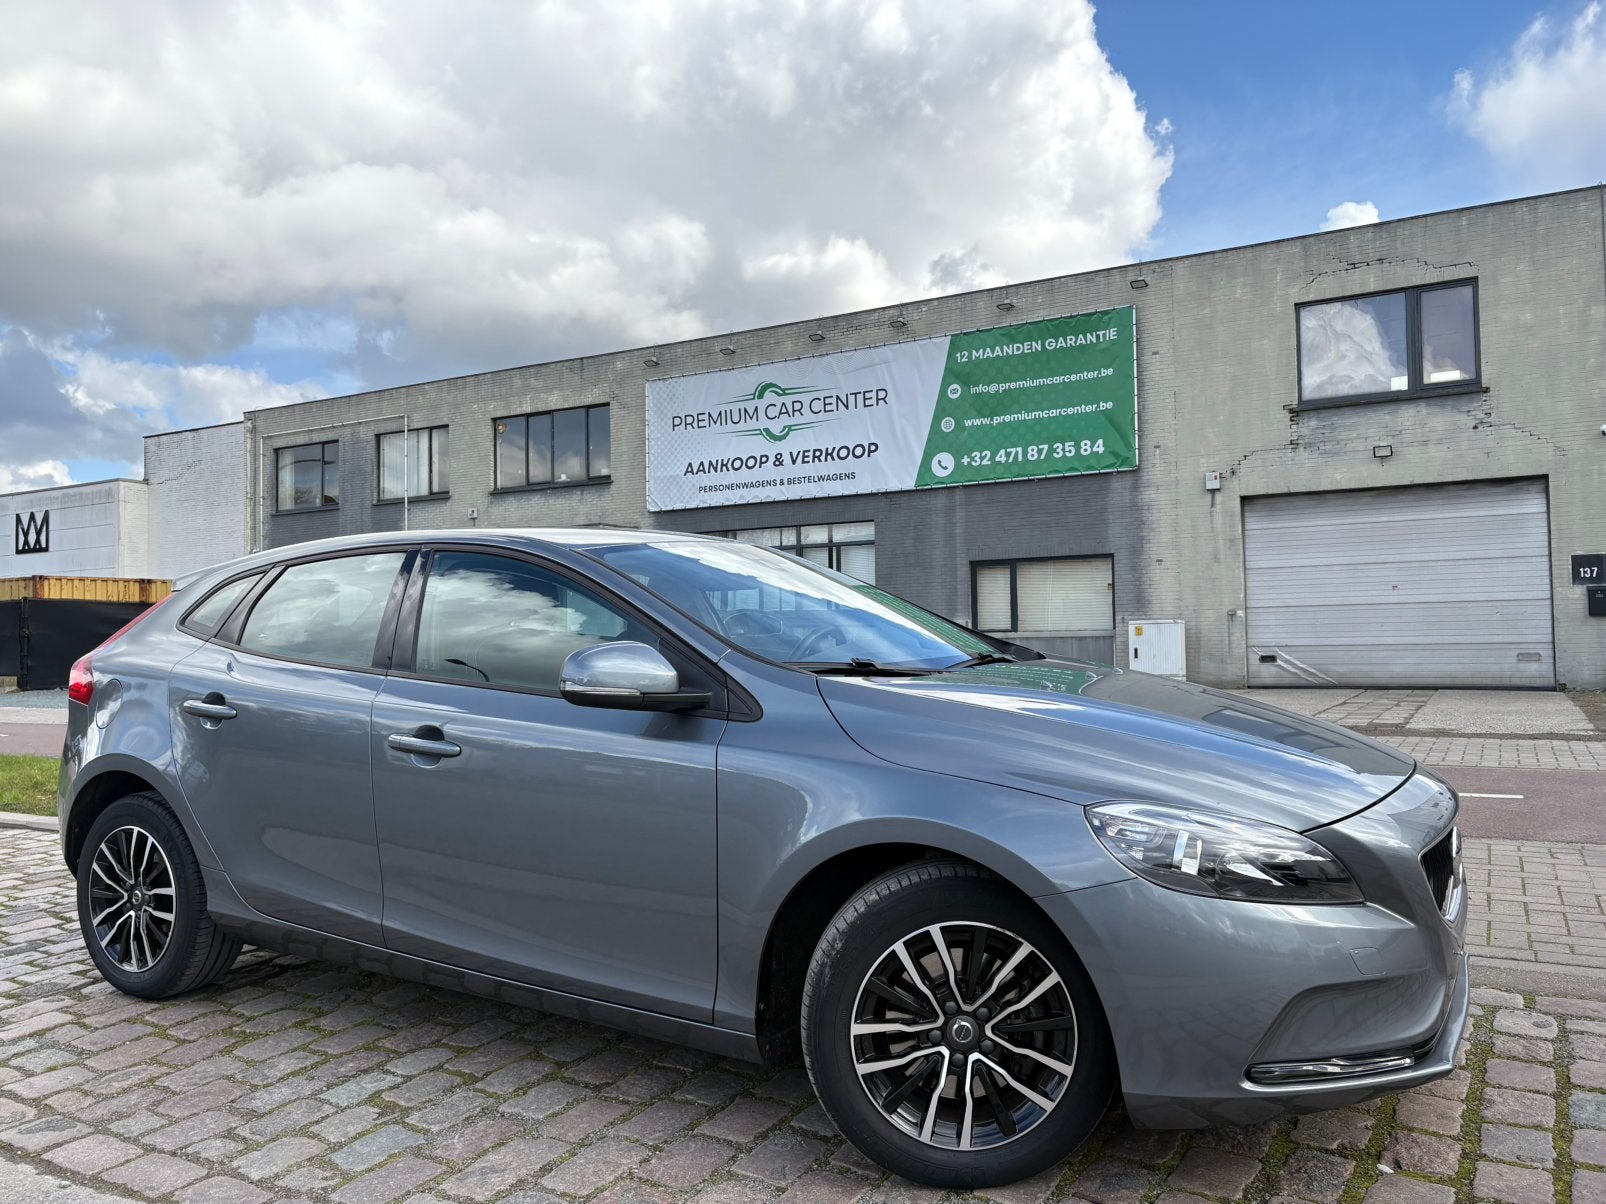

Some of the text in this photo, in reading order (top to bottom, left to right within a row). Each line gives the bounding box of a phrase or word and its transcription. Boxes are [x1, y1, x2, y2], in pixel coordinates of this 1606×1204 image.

[955, 328, 1118, 363] 12 MAANDEN GARANTIE
[970, 367, 1113, 395] info@premiumcarcenter.be
[672, 387, 889, 432] PREMIUM CAR CENTER
[964, 401, 1113, 427] www.premiumcarcenter.be
[684, 442, 879, 477] AANKOOP & VERKOOP
[961, 438, 1105, 466] +32 471 87 35 84
[698, 471, 856, 493] PERSONENWAGENS & BESTELWAGENS
[1579, 567, 1598, 578] 137
